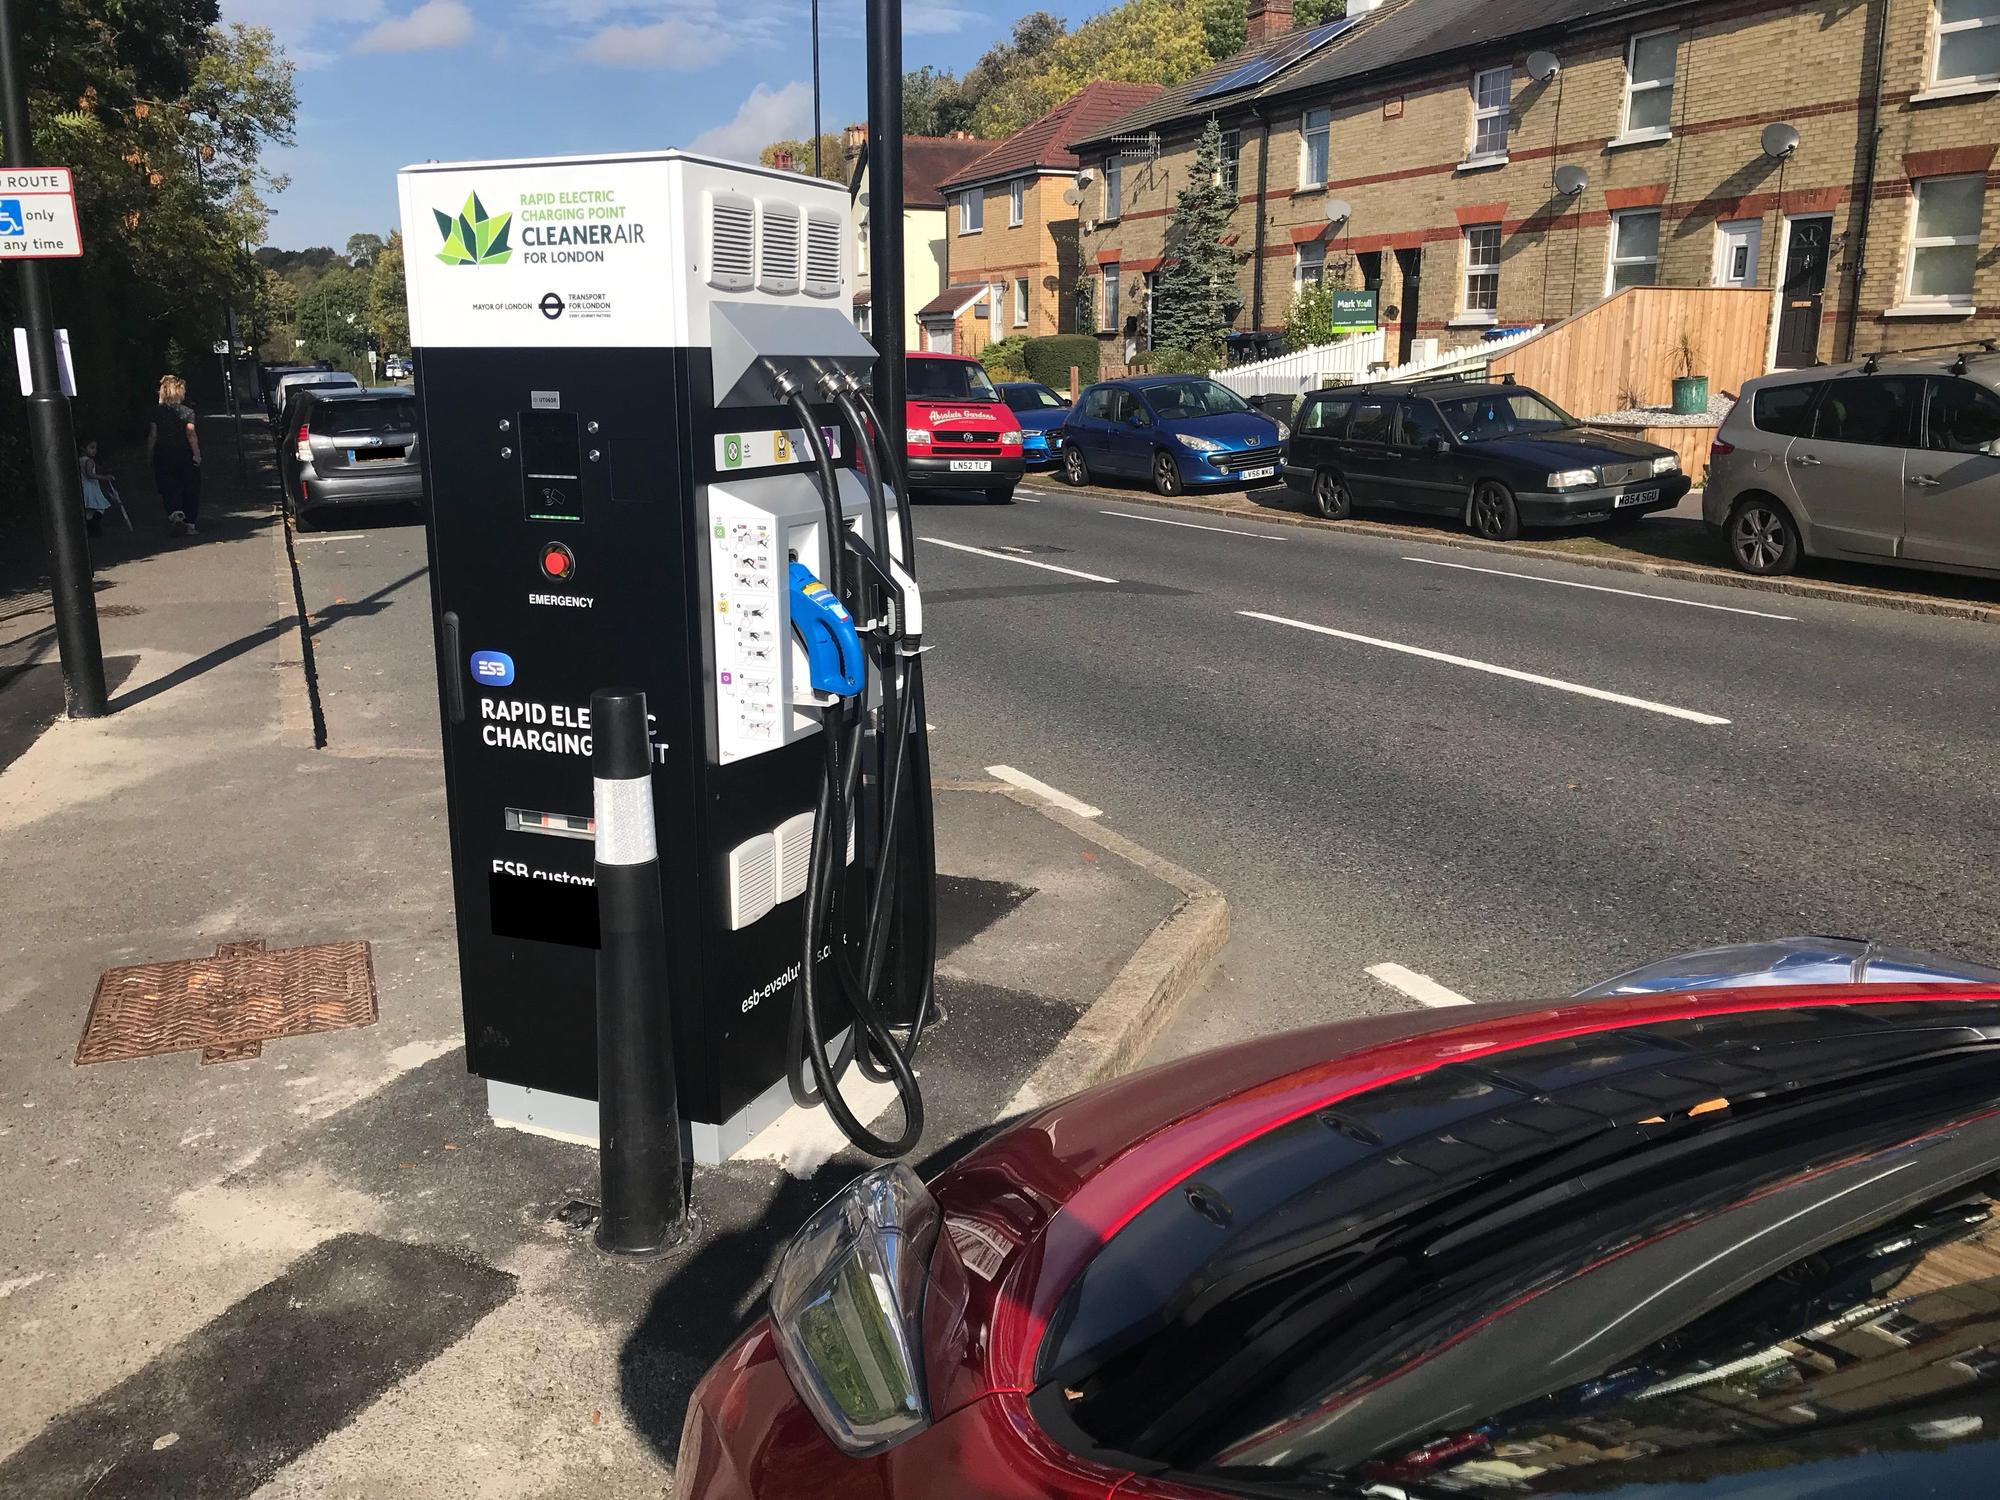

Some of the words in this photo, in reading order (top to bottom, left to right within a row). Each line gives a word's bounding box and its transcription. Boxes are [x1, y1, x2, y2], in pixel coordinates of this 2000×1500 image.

[7, 176, 59, 188] ROUTE
[520, 193, 555, 206] RAPID
[559, 190, 615, 204] ELECTRIC
[26, 209, 54, 222] only
[521, 208, 584, 222] CHARGING
[588, 206, 626, 220] POINT
[4, 241, 27, 252] any
[33, 238, 64, 250] time
[524, 252, 547, 264] FOR
[551, 250, 604, 264] LONDON
[568, 293, 606, 301] TRANSPORT
[1337, 299, 1355, 308] Mark
[472, 303, 494, 311] MAYOR
[505, 302, 533, 310] LONDON
[568, 302, 581, 310] FOR
[929, 410, 962, 422] Absolute
[963, 410, 997, 421] Gardens
[953, 461, 973, 470] LN52
[974, 461, 988, 470] TLF
[1641, 490, 1657, 502] SGU
[529, 593, 594, 608] EMERGENCY
[478, 660, 506, 677] ESB
[481, 698, 546, 725] RAPID
[482, 725, 593, 757] CHARGING
